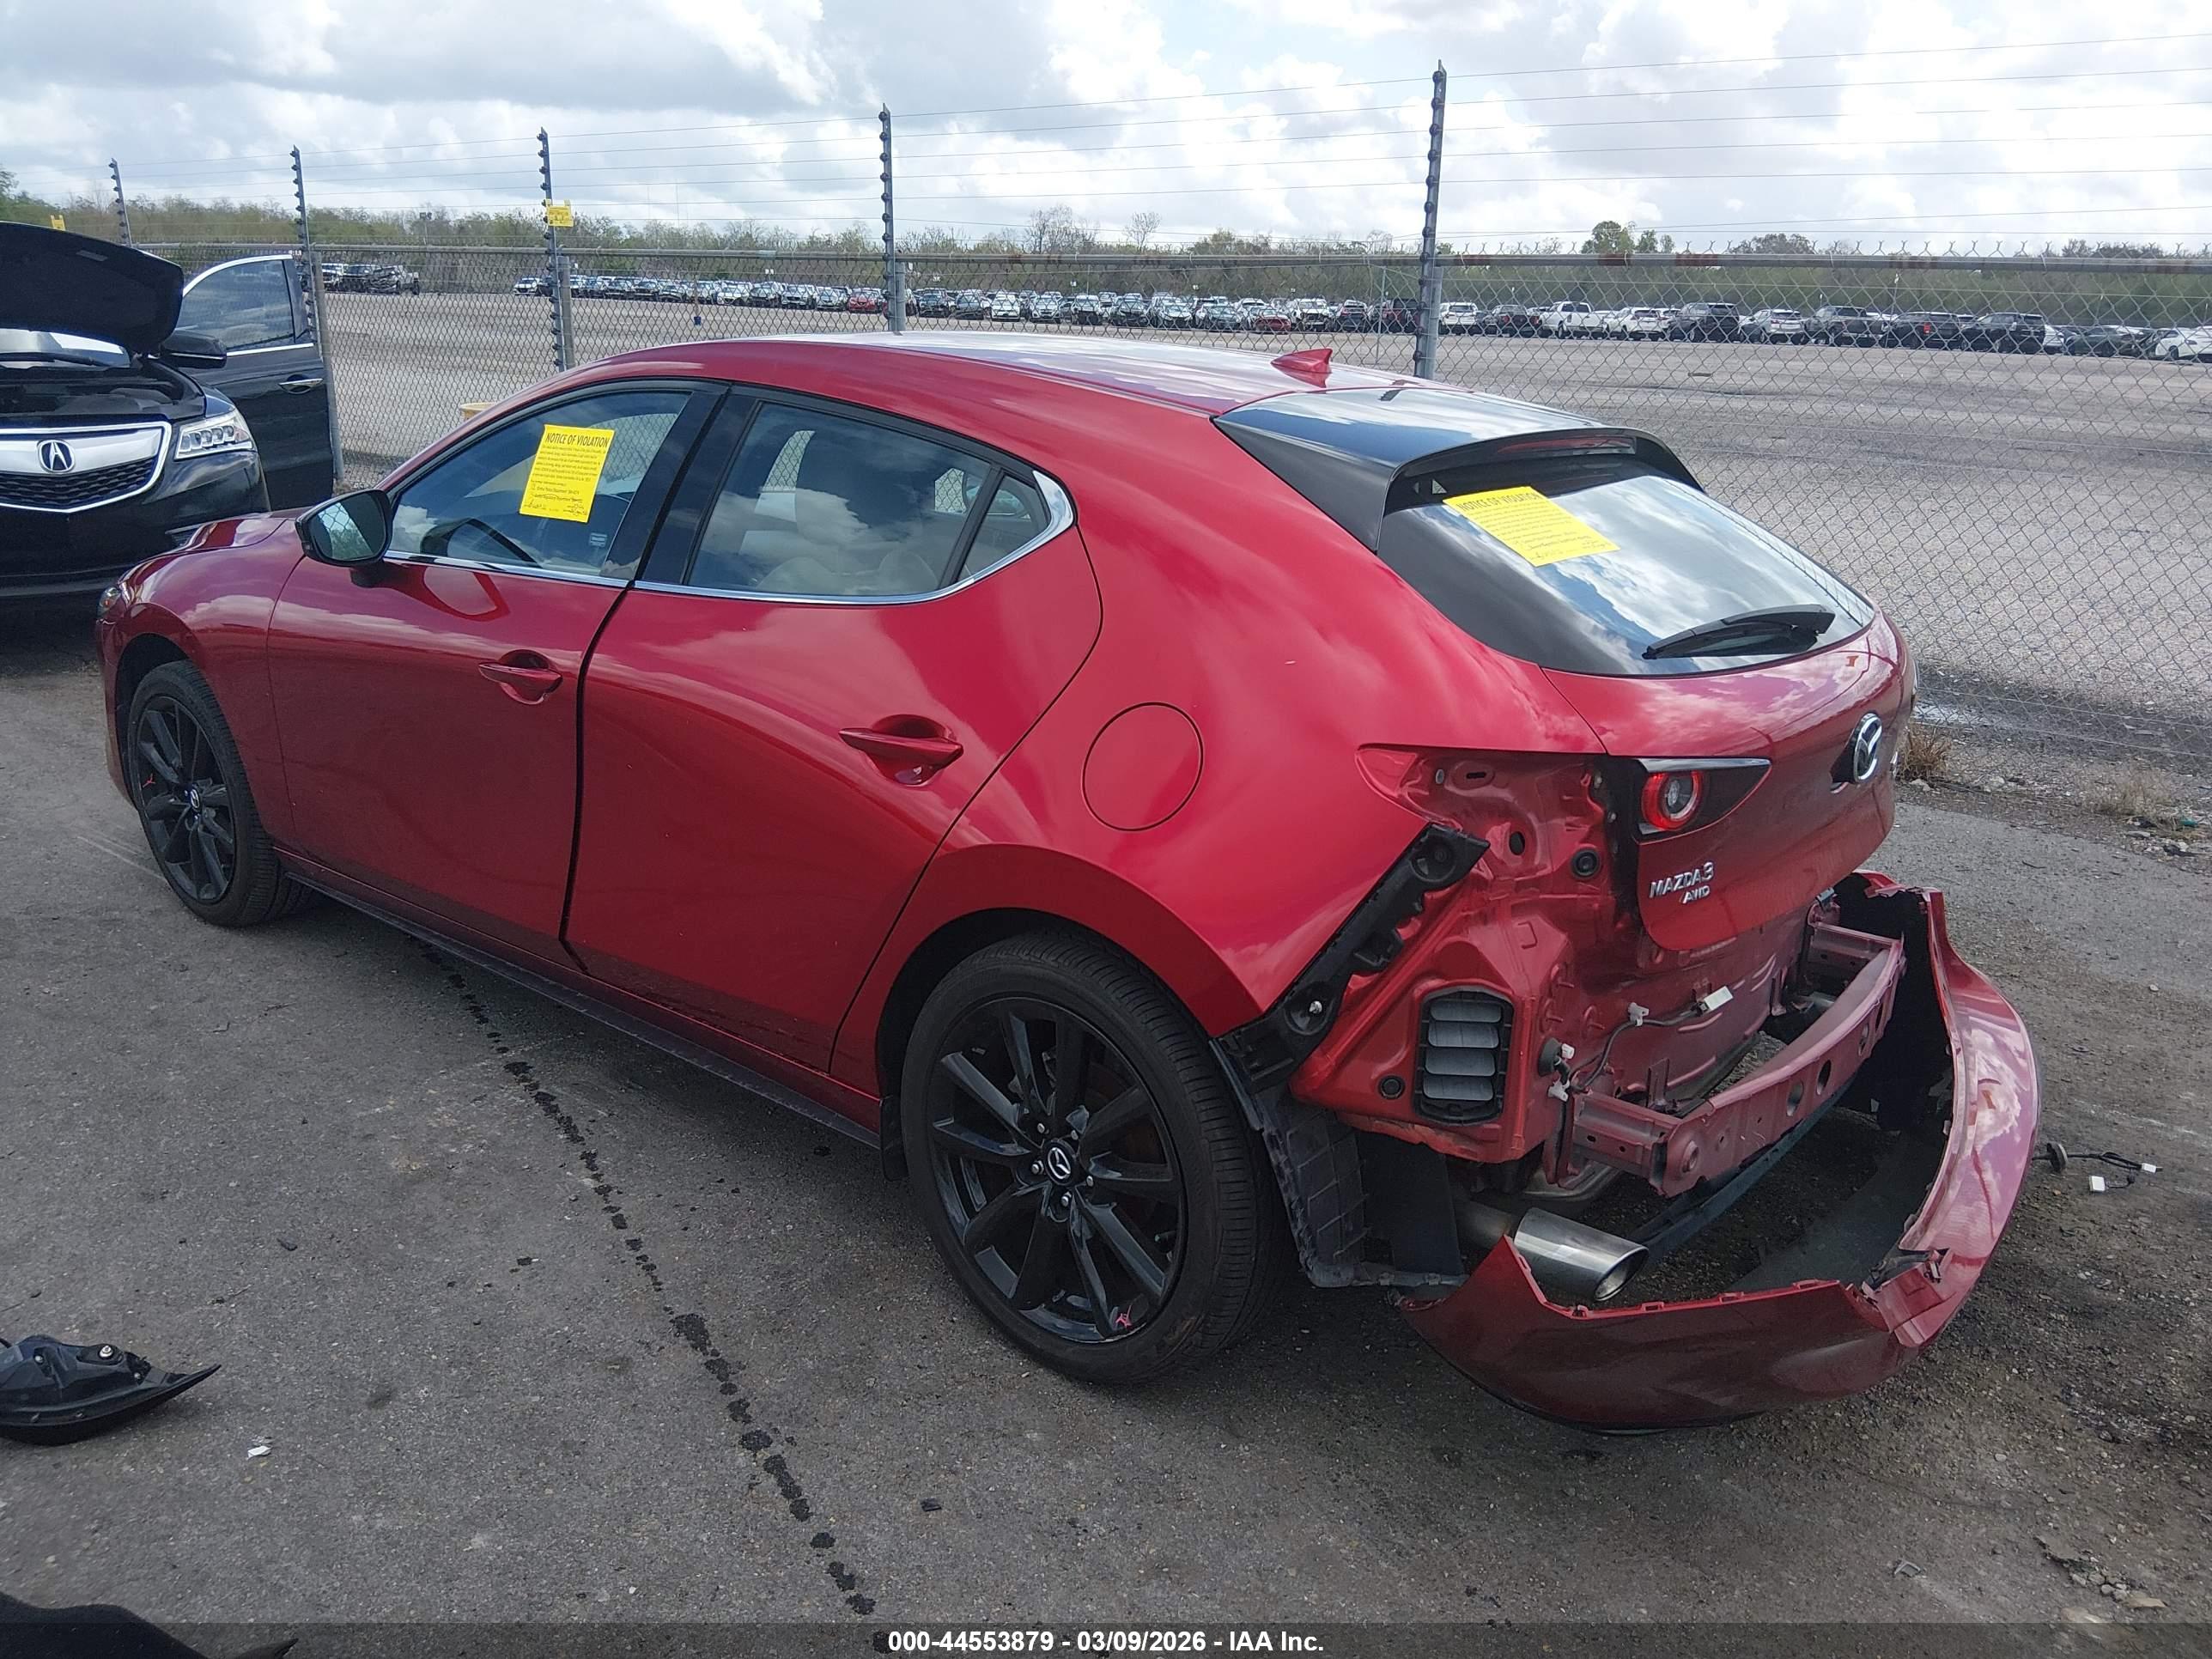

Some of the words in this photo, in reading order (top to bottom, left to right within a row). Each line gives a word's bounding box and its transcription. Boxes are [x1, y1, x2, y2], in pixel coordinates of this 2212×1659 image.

[546, 433, 567, 444] NOTICE
[568, 434, 576, 445] OF
[577, 435, 610, 447] VIOLATION
[1456, 500, 1492, 512] NOTICE
[1486, 497, 1502, 506] OF
[1681, 885, 1711, 904] AWD
